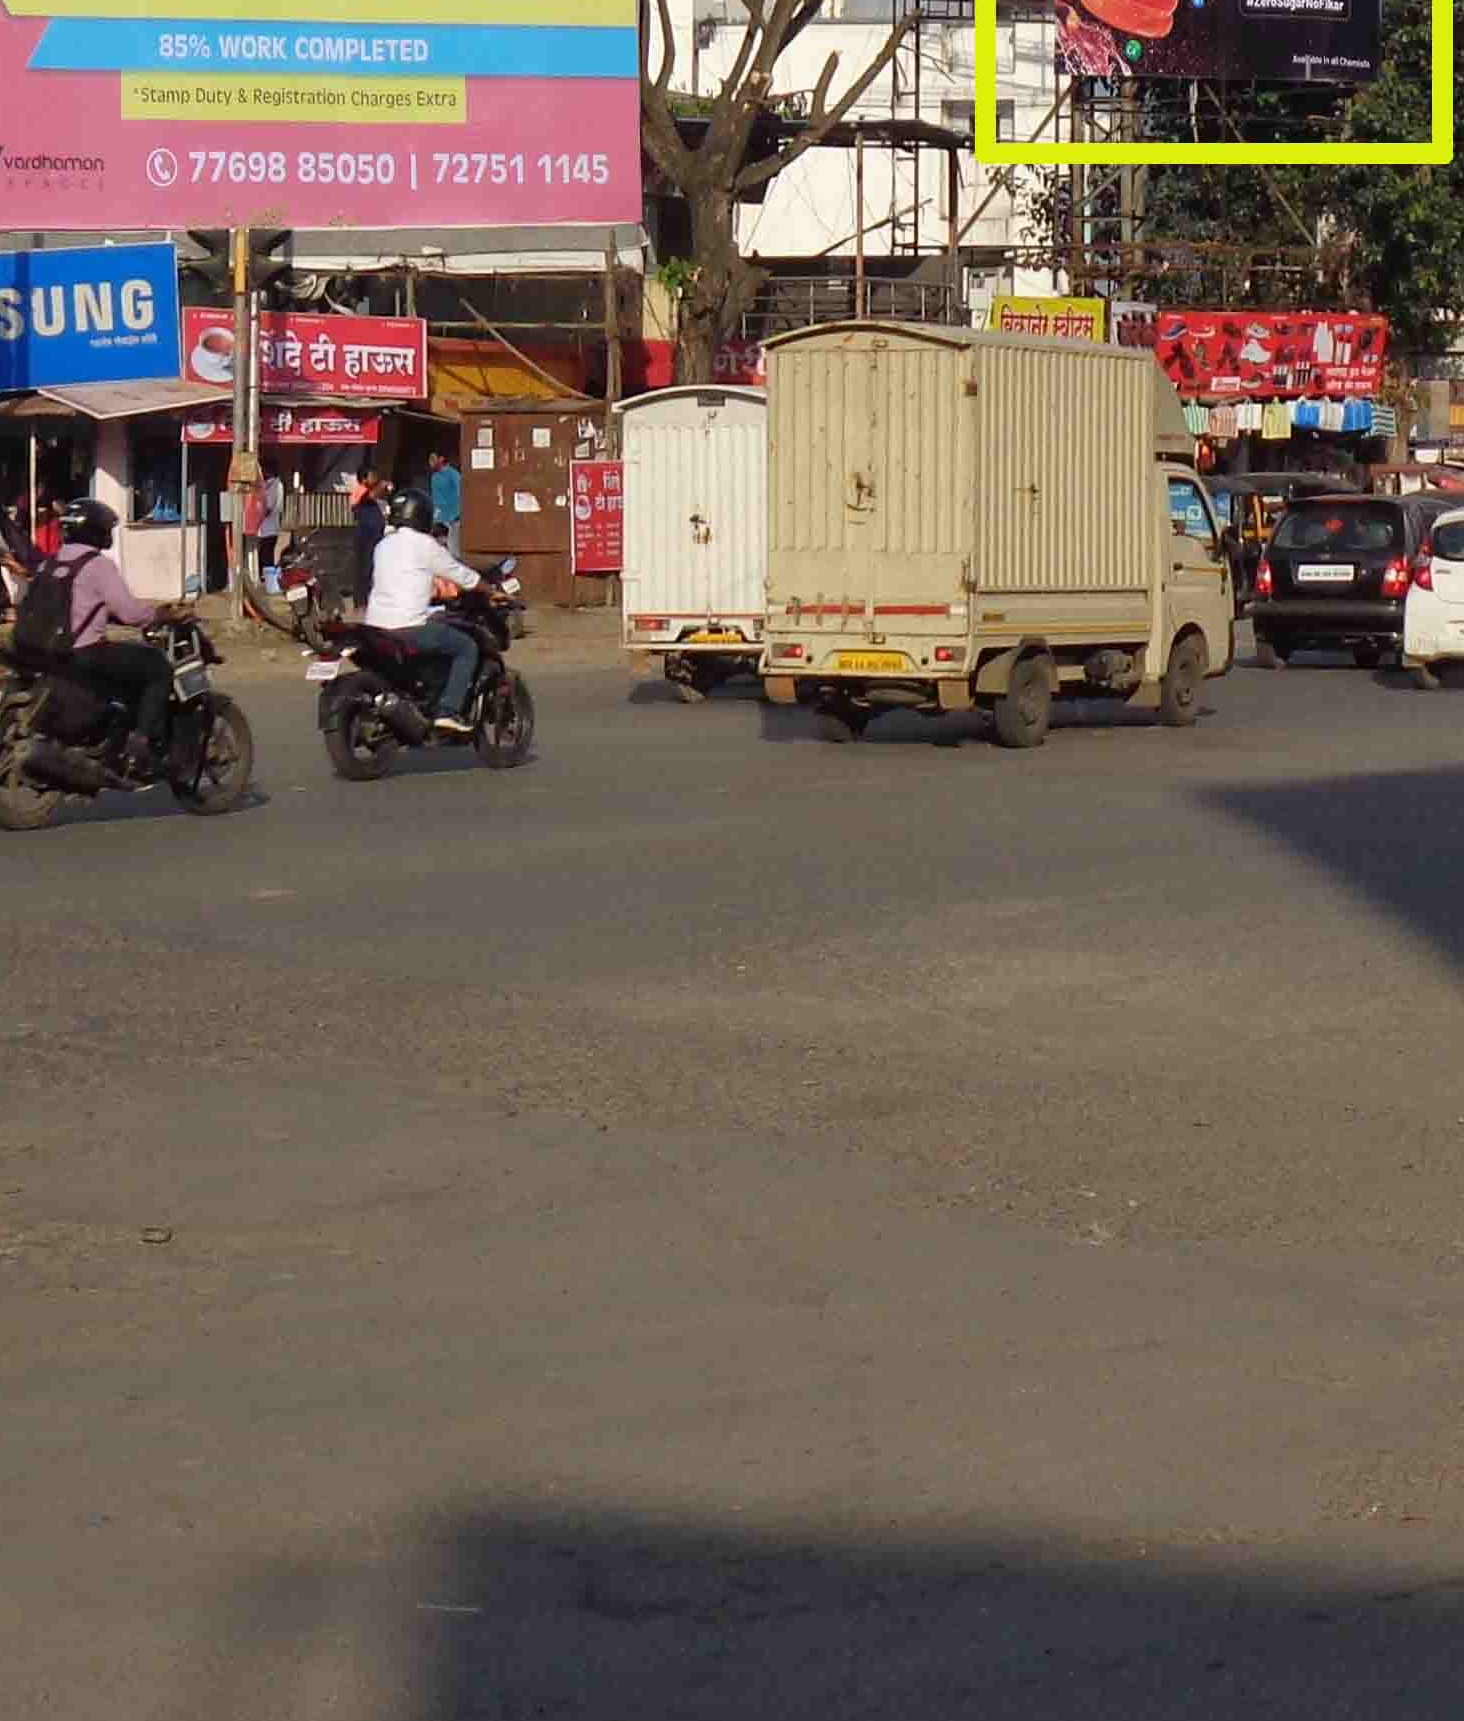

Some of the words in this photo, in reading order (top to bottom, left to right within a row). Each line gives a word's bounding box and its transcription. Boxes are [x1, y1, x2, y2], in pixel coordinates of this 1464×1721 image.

[159, 33, 211, 60] 85%
[218, 35, 287, 60] WORK
[295, 35, 429, 63] COMPLETED
[195, 88, 232, 108] Duty
[237, 89, 249, 106] &
[253, 88, 346, 109] Registration
[350, 91, 414, 112] Charges
[417, 91, 457, 108] Extra
[4, 154, 105, 172] vardhaman
[189, 151, 287, 184] 77698
[297, 152, 396, 186] 85050
[433, 153, 526, 185] 72751
[536, 153, 610, 185] 1145
[309, 333, 336, 372] टी
[343, 344, 416, 378] हाऊस
